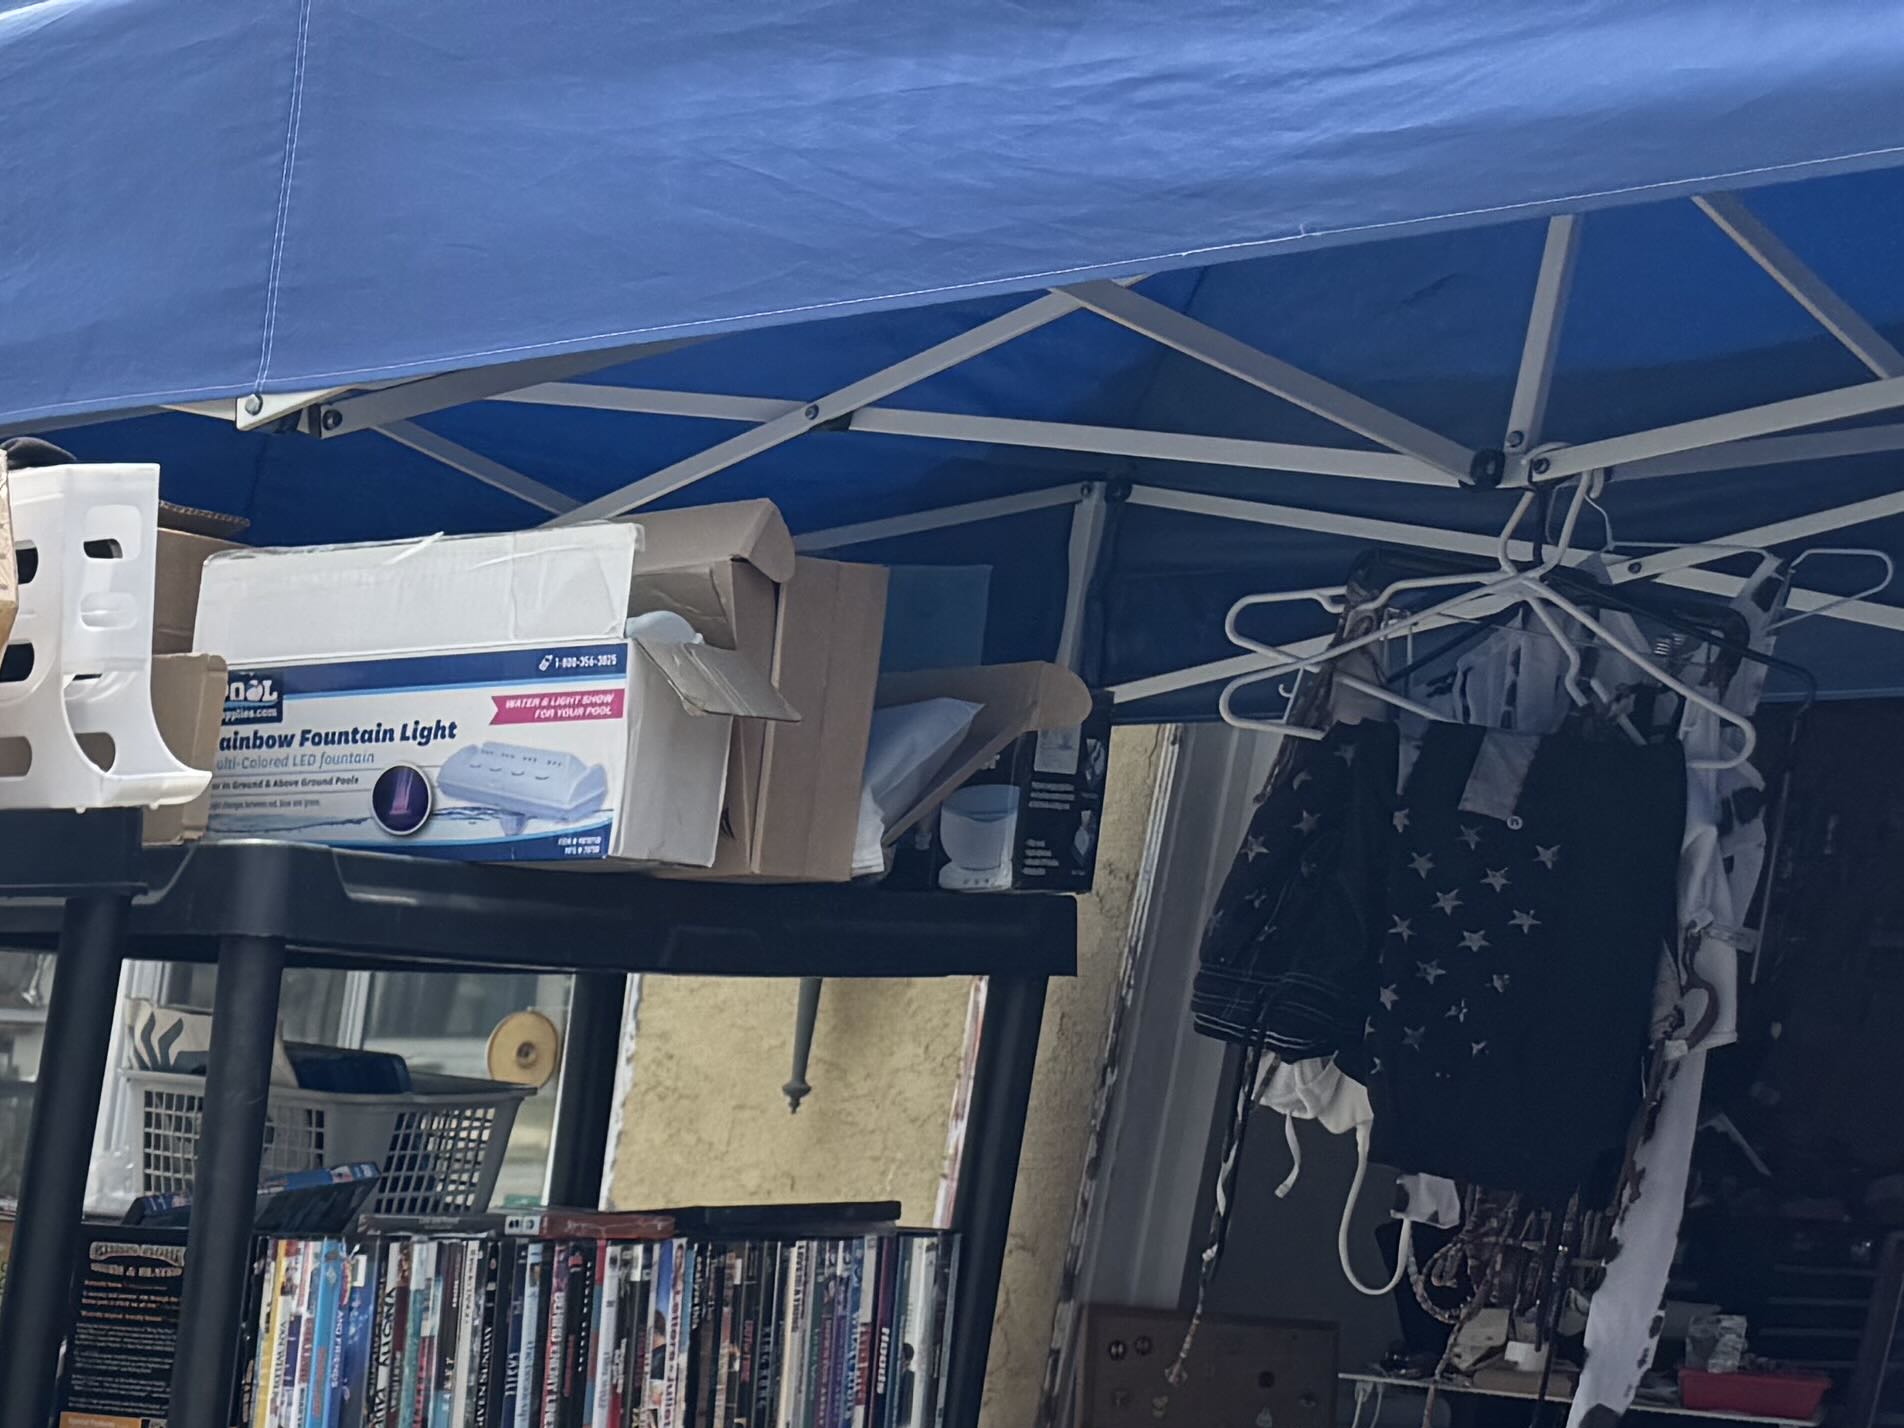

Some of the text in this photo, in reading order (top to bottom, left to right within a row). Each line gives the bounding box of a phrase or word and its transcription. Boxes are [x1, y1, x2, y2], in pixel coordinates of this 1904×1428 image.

[549, 695, 580, 706] LIGHT
[220, 720, 459, 752] ainbow Fountain Light
[217, 752, 375, 770] ulti-Colored LED fountain
[273, 777, 299, 789] Above
[301, 776, 334, 788] Ground
